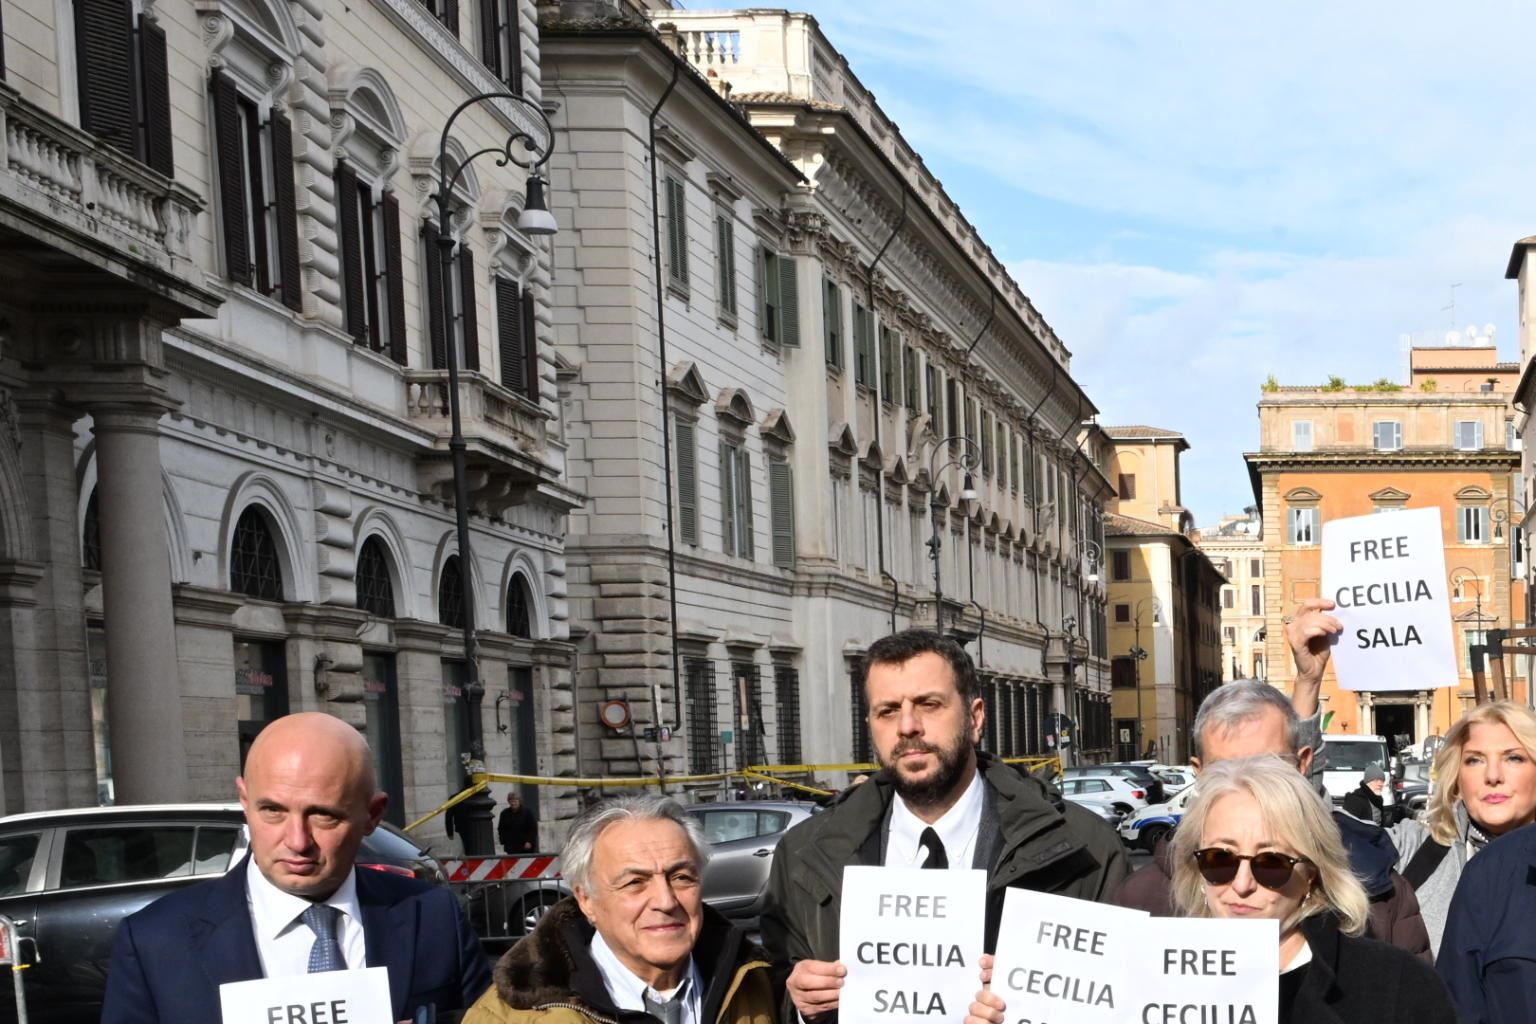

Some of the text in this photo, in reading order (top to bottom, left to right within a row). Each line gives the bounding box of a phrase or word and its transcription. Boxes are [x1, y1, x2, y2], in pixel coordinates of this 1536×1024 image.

[1350, 535, 1410, 563] FREE
[1335, 579, 1433, 609] CECILIA
[1356, 625, 1423, 649] SALA
[878, 894, 947, 919] FREE
[1038, 922, 1107, 956] FREE
[856, 941, 966, 968] CECILIA
[1163, 948, 1237, 976] FREE
[1007, 967, 1115, 1009] CECILIA
[874, 989, 947, 1016] SALA
